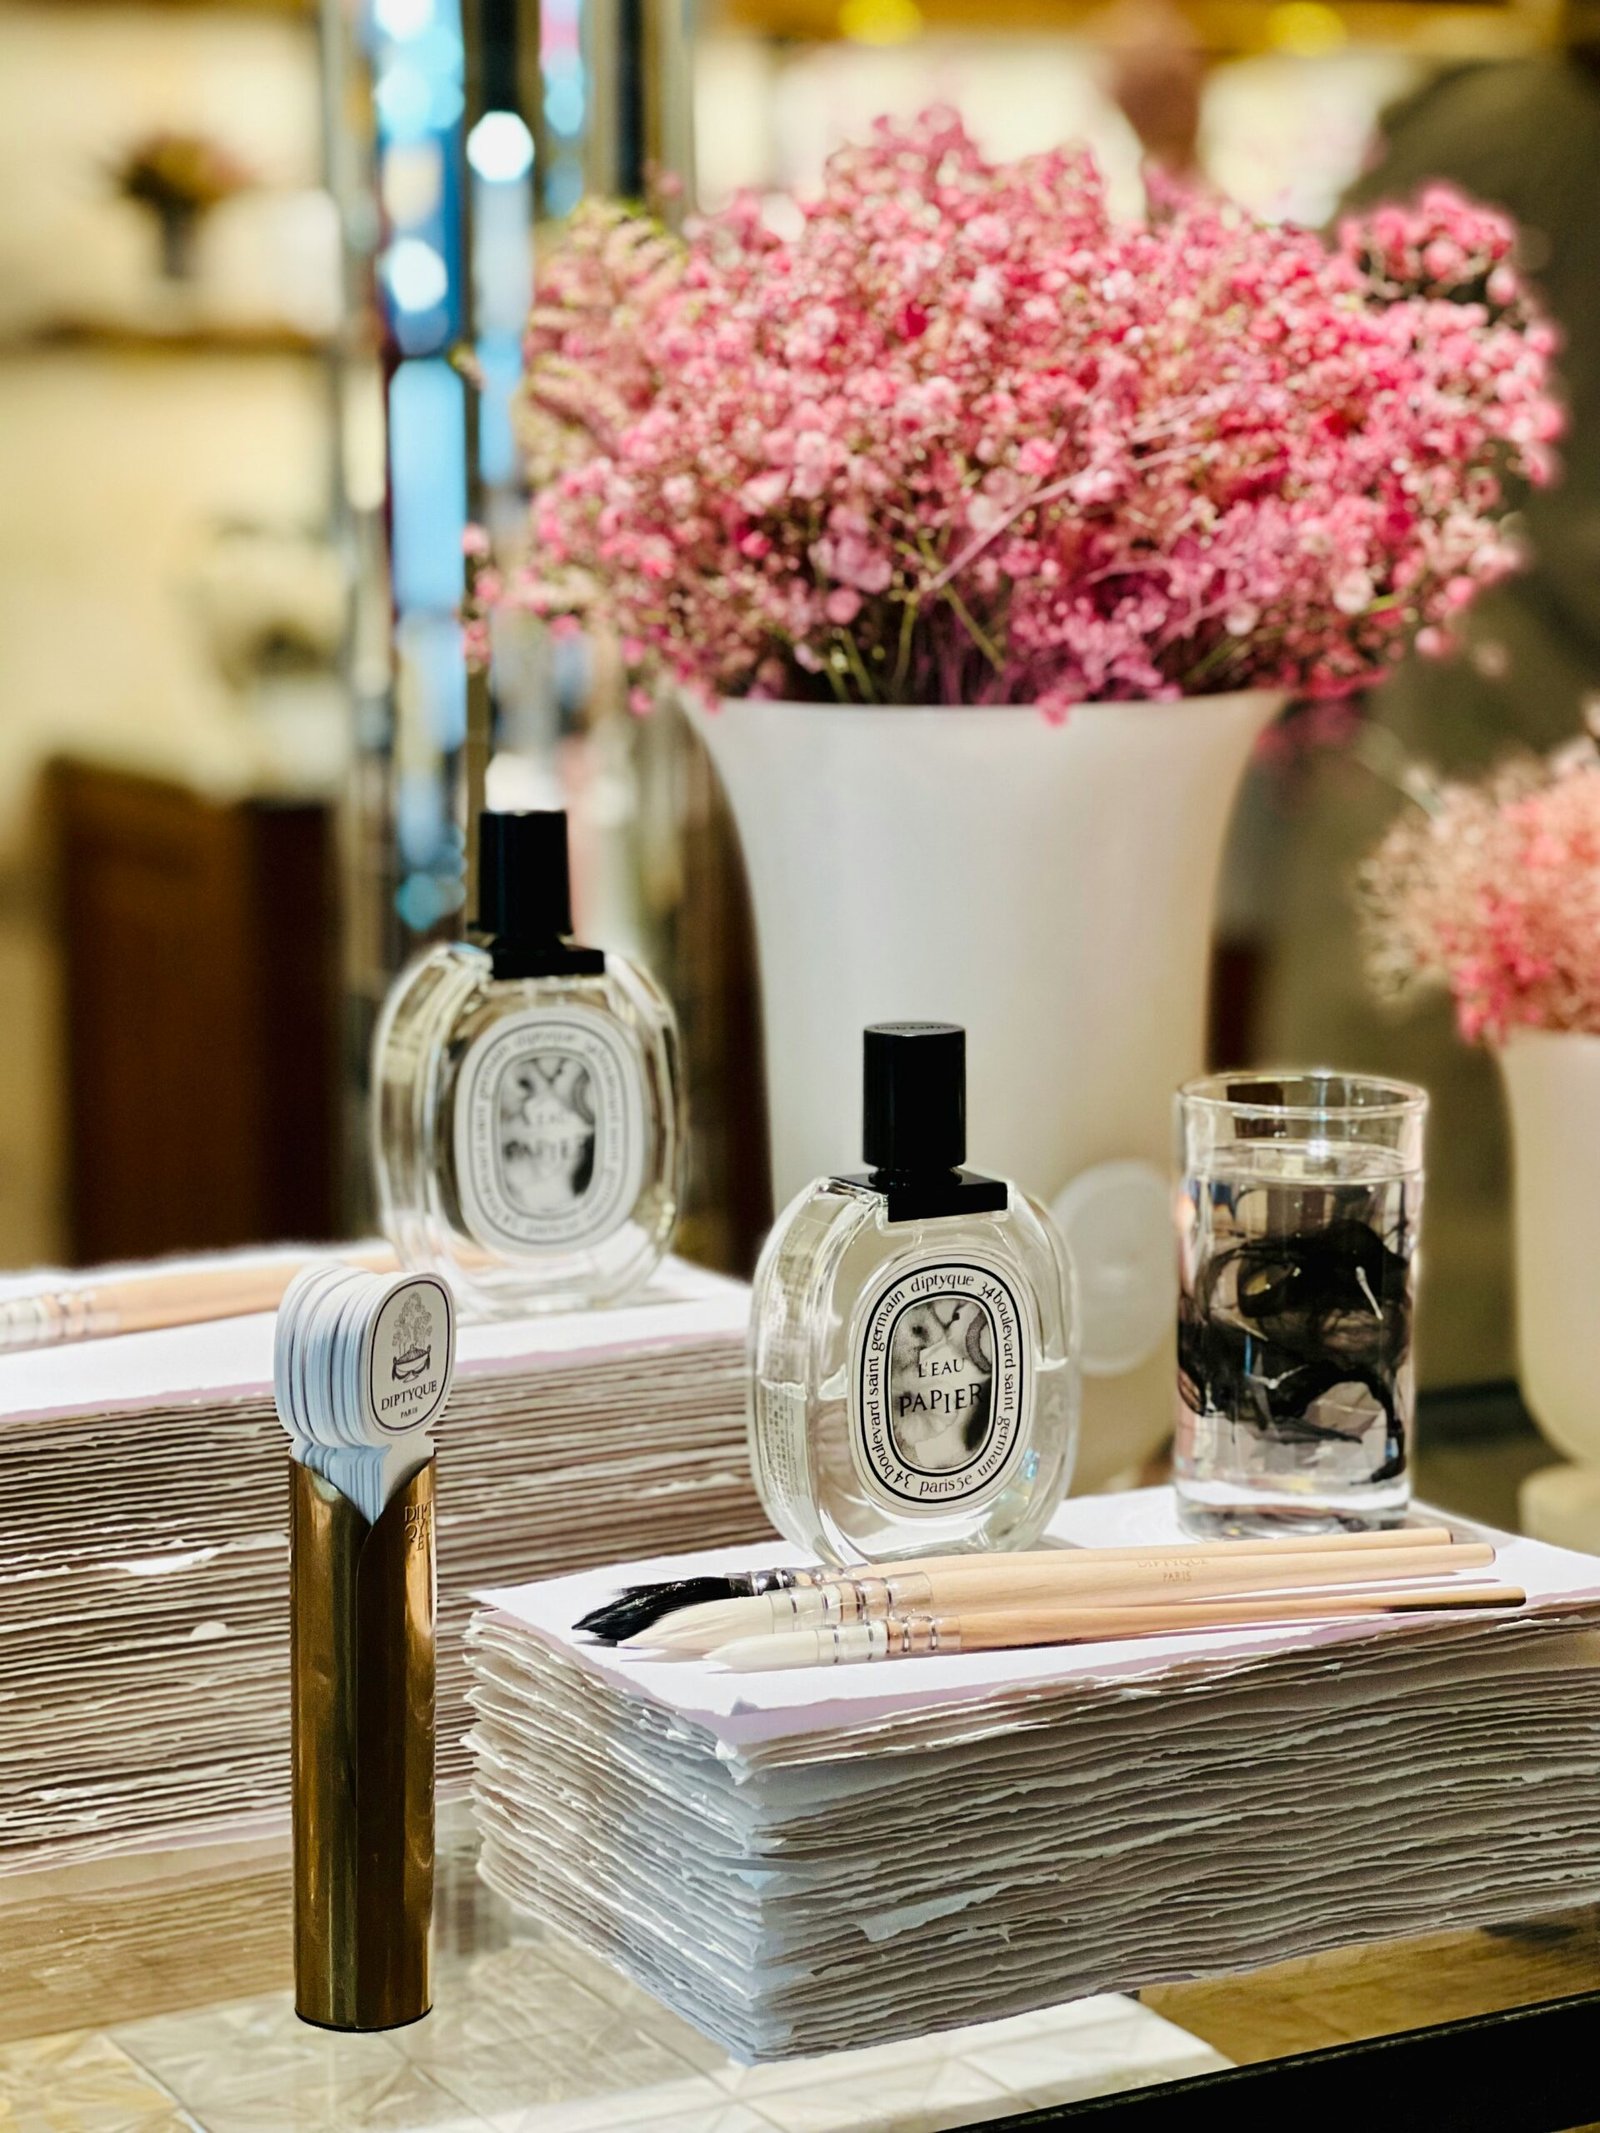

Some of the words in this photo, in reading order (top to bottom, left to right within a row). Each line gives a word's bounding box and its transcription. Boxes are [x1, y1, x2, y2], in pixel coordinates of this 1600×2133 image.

[910, 1273, 975, 1293] diptyque
[871, 1290, 906, 1352] germain
[865, 1356, 880, 1396] saint
[917, 1357, 966, 1379] L'EAU
[381, 1379, 438, 1412] DIPTYQUE
[898, 1382, 984, 1418] PAPIER
[1003, 1373, 1017, 1412] saint
[400, 1406, 418, 1419] PARIS
[977, 1416, 1011, 1477] germain
[1162, 1569, 1193, 1584] PARIS
